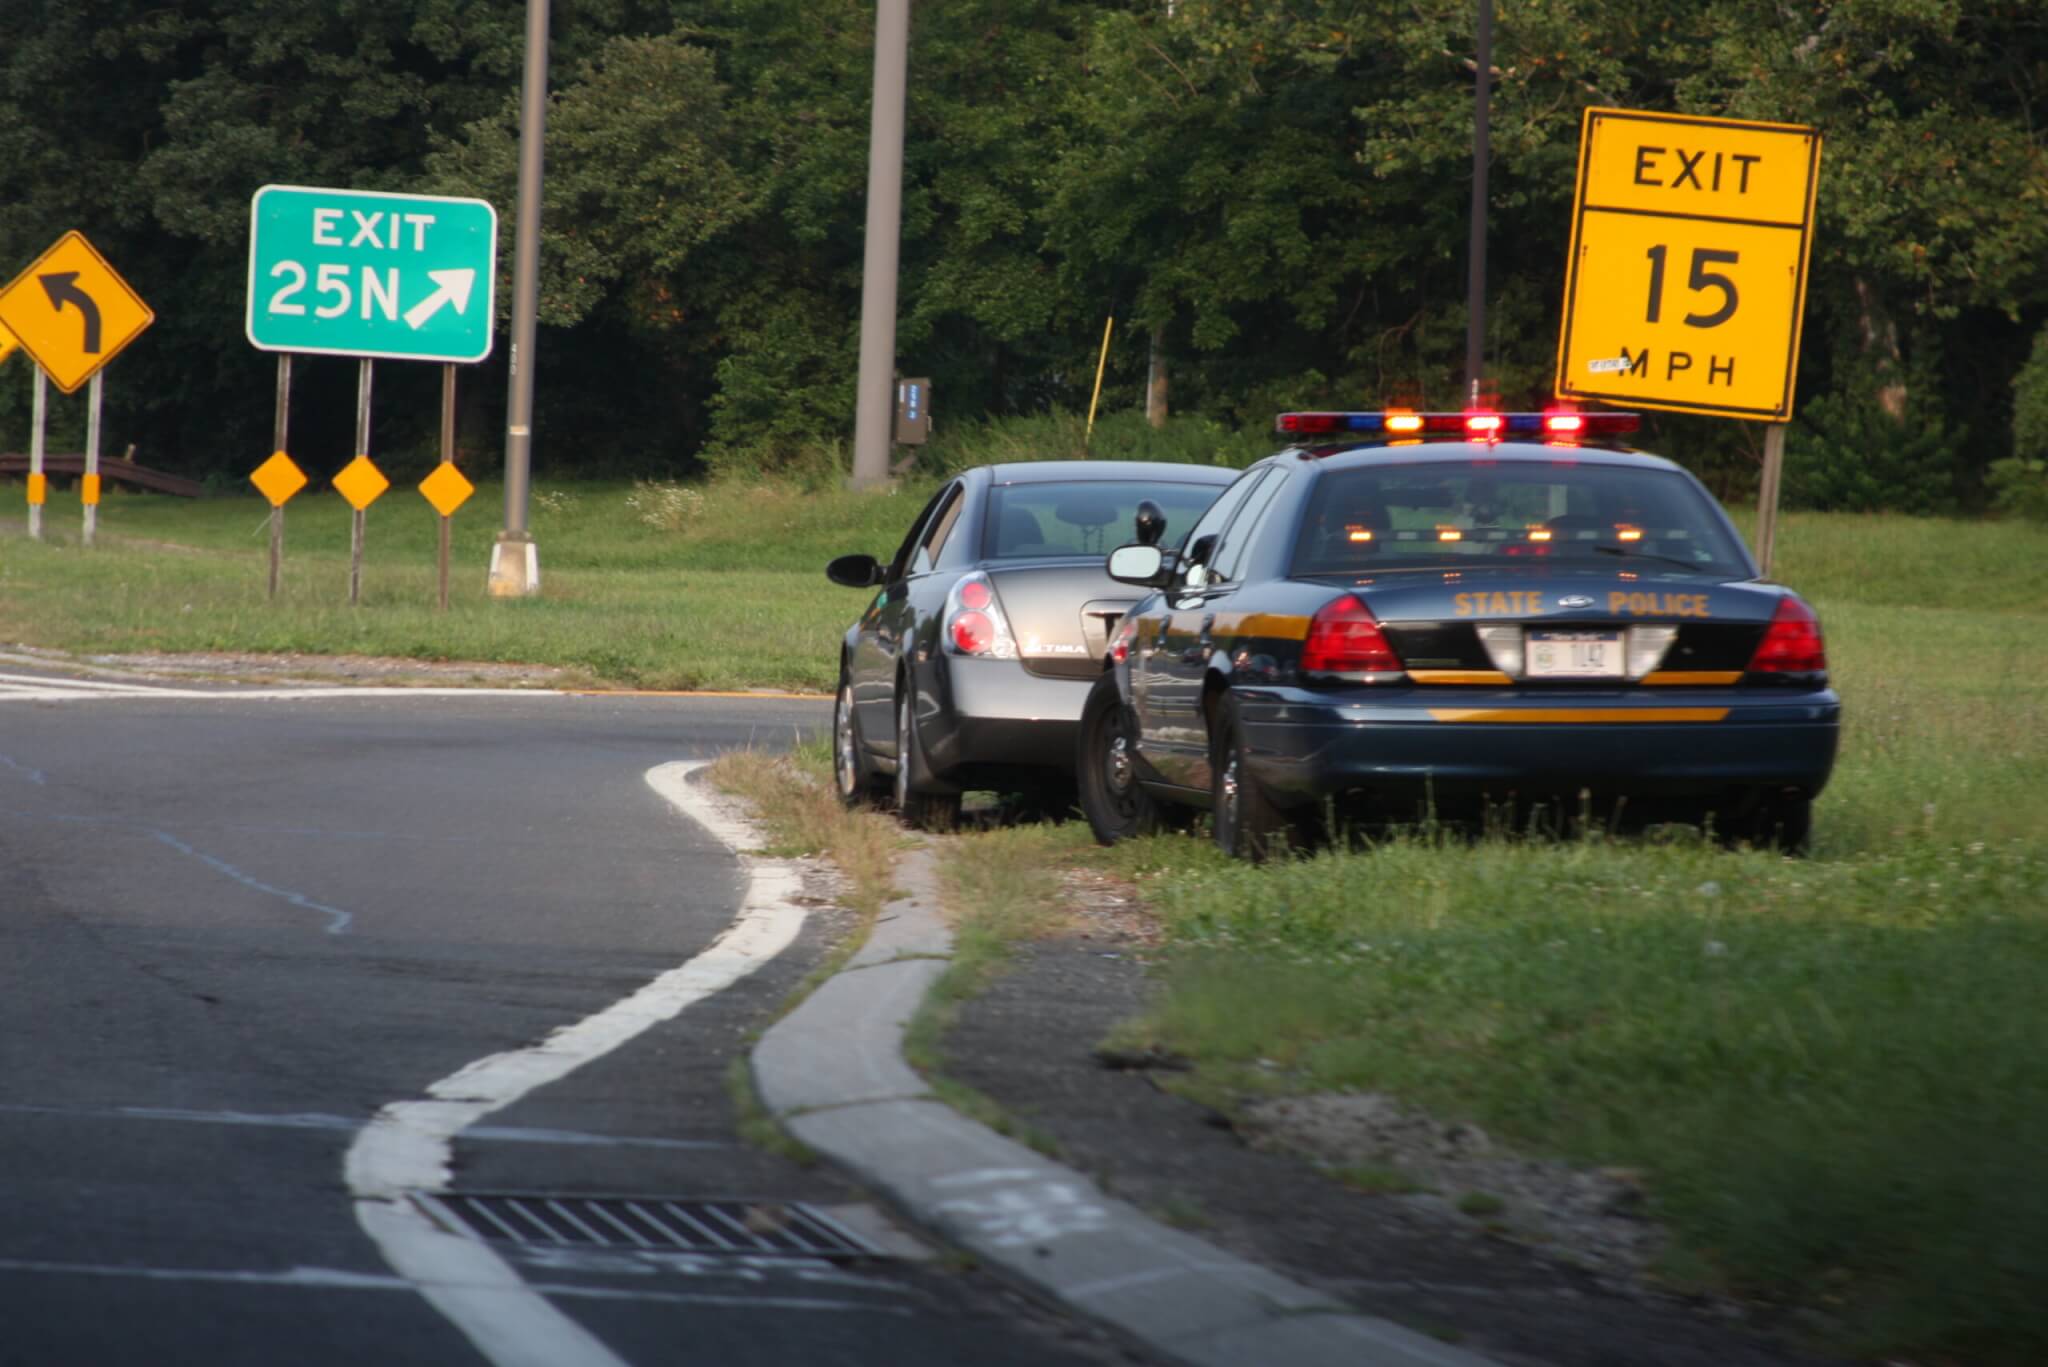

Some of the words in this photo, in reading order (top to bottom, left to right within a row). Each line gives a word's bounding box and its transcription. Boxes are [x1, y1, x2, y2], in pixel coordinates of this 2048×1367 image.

[1634, 145, 1761, 194] EXIT
[312, 207, 436, 251] EXIT
[268, 259, 399, 321] 25N
[1645, 244, 1740, 329] 15
[1455, 590, 1545, 616] STATE
[1607, 591, 1712, 618] POLICE
